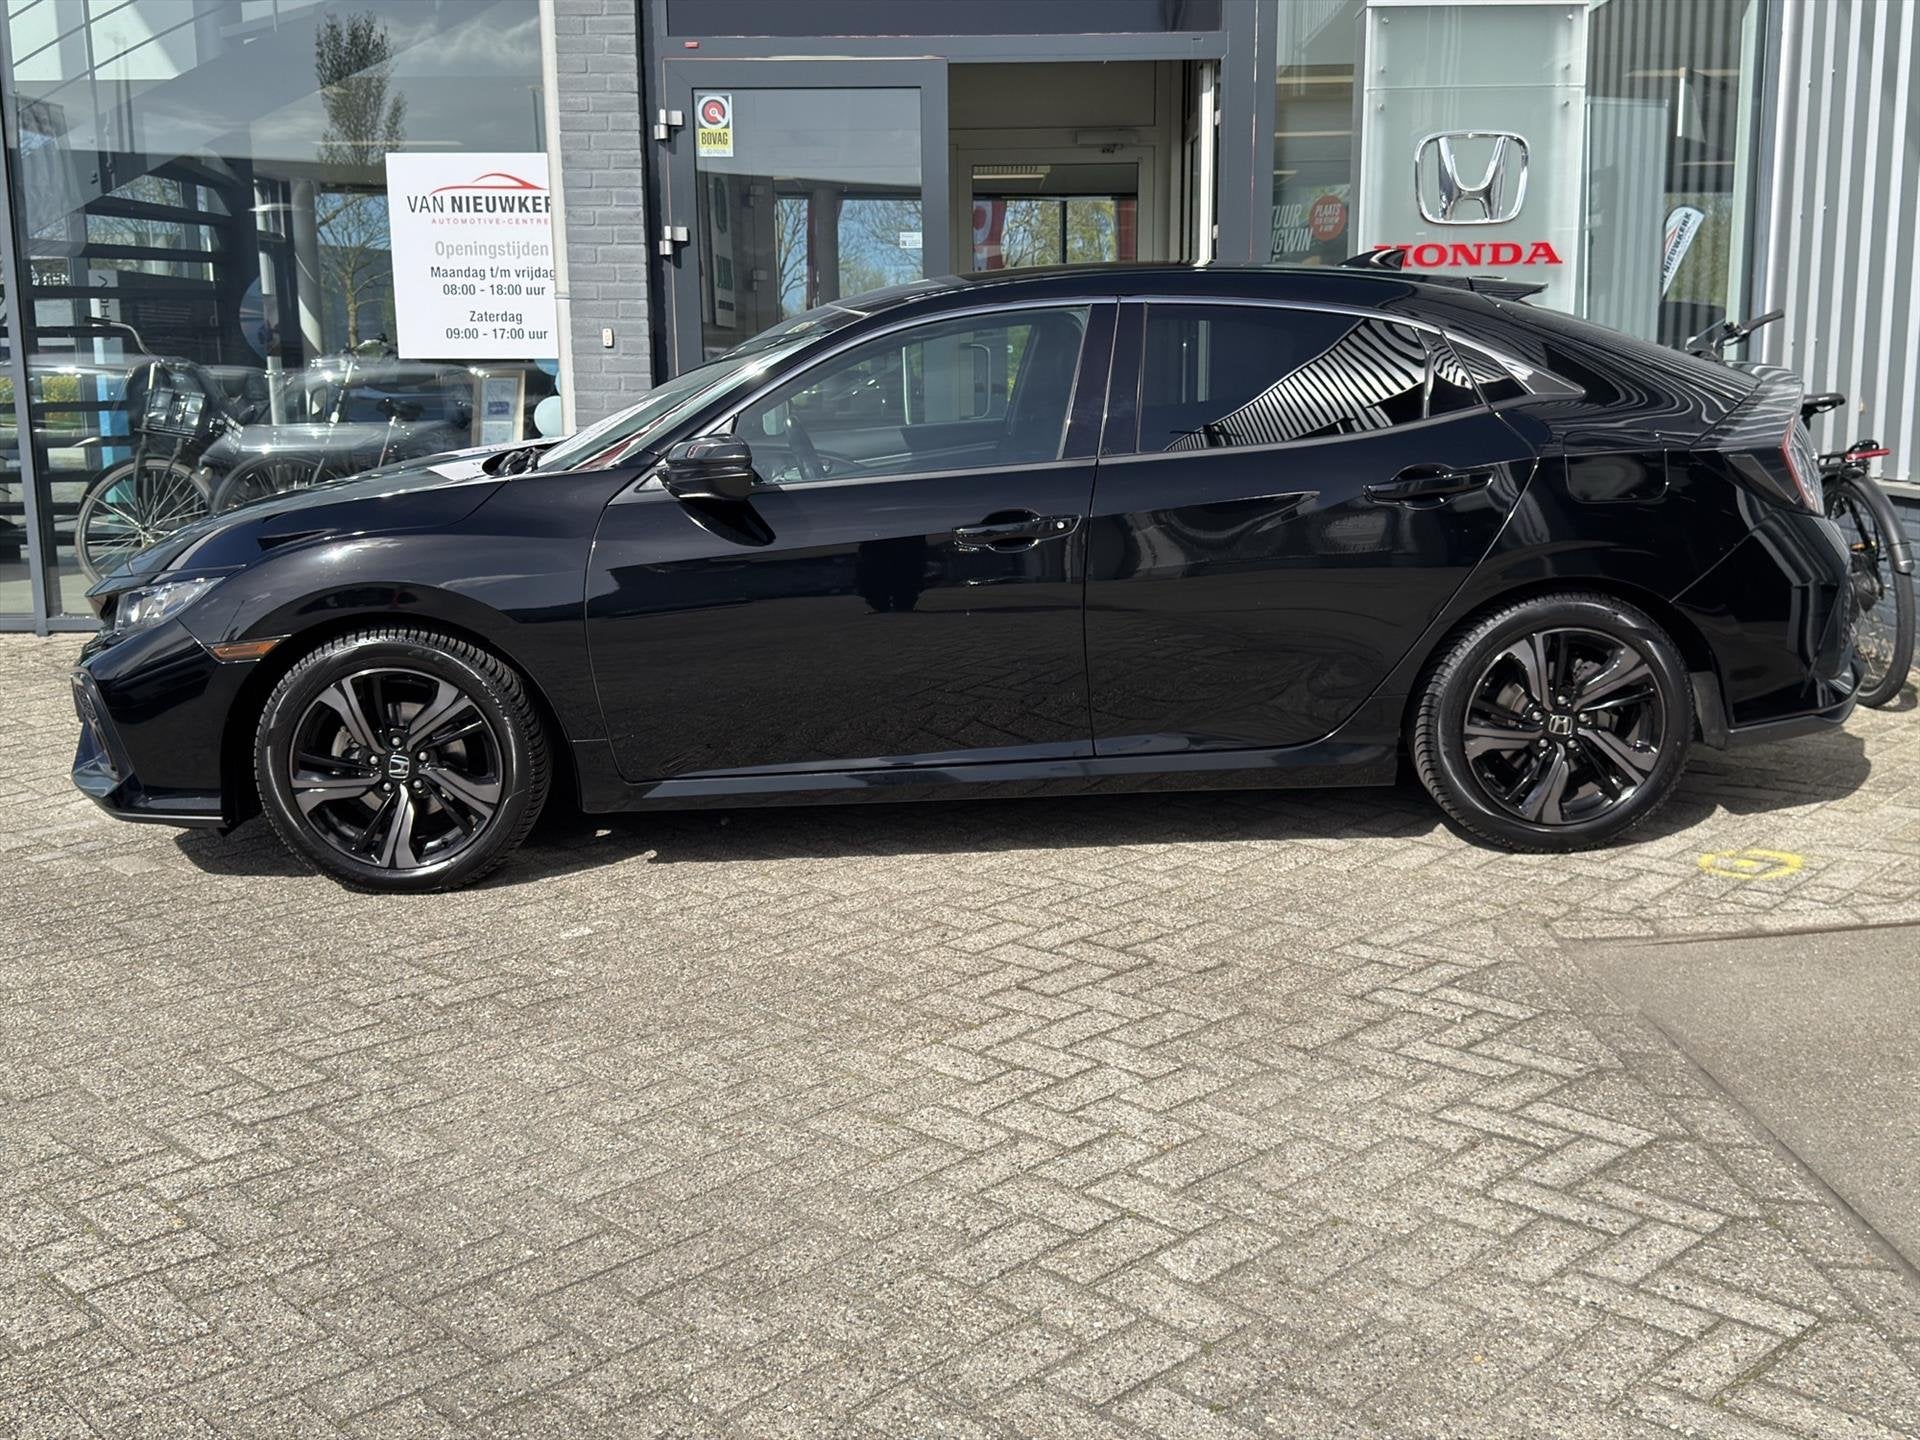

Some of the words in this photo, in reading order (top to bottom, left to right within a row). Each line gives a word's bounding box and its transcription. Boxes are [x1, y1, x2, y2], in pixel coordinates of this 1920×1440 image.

[701, 132, 728, 145] BOVAG
[407, 196, 444, 213] VAN
[434, 241, 549, 260] Openingstijden
[430, 266, 486, 280] Maandag
[490, 267, 511, 278] t/m
[442, 284, 476, 296] 08:00
[490, 284, 522, 296] 18:00
[525, 285, 546, 296] uur
[469, 311, 523, 324] Zaterdag
[446, 328, 479, 340] 09:00
[492, 328, 525, 340] 17:00
[528, 329, 549, 340] uur
